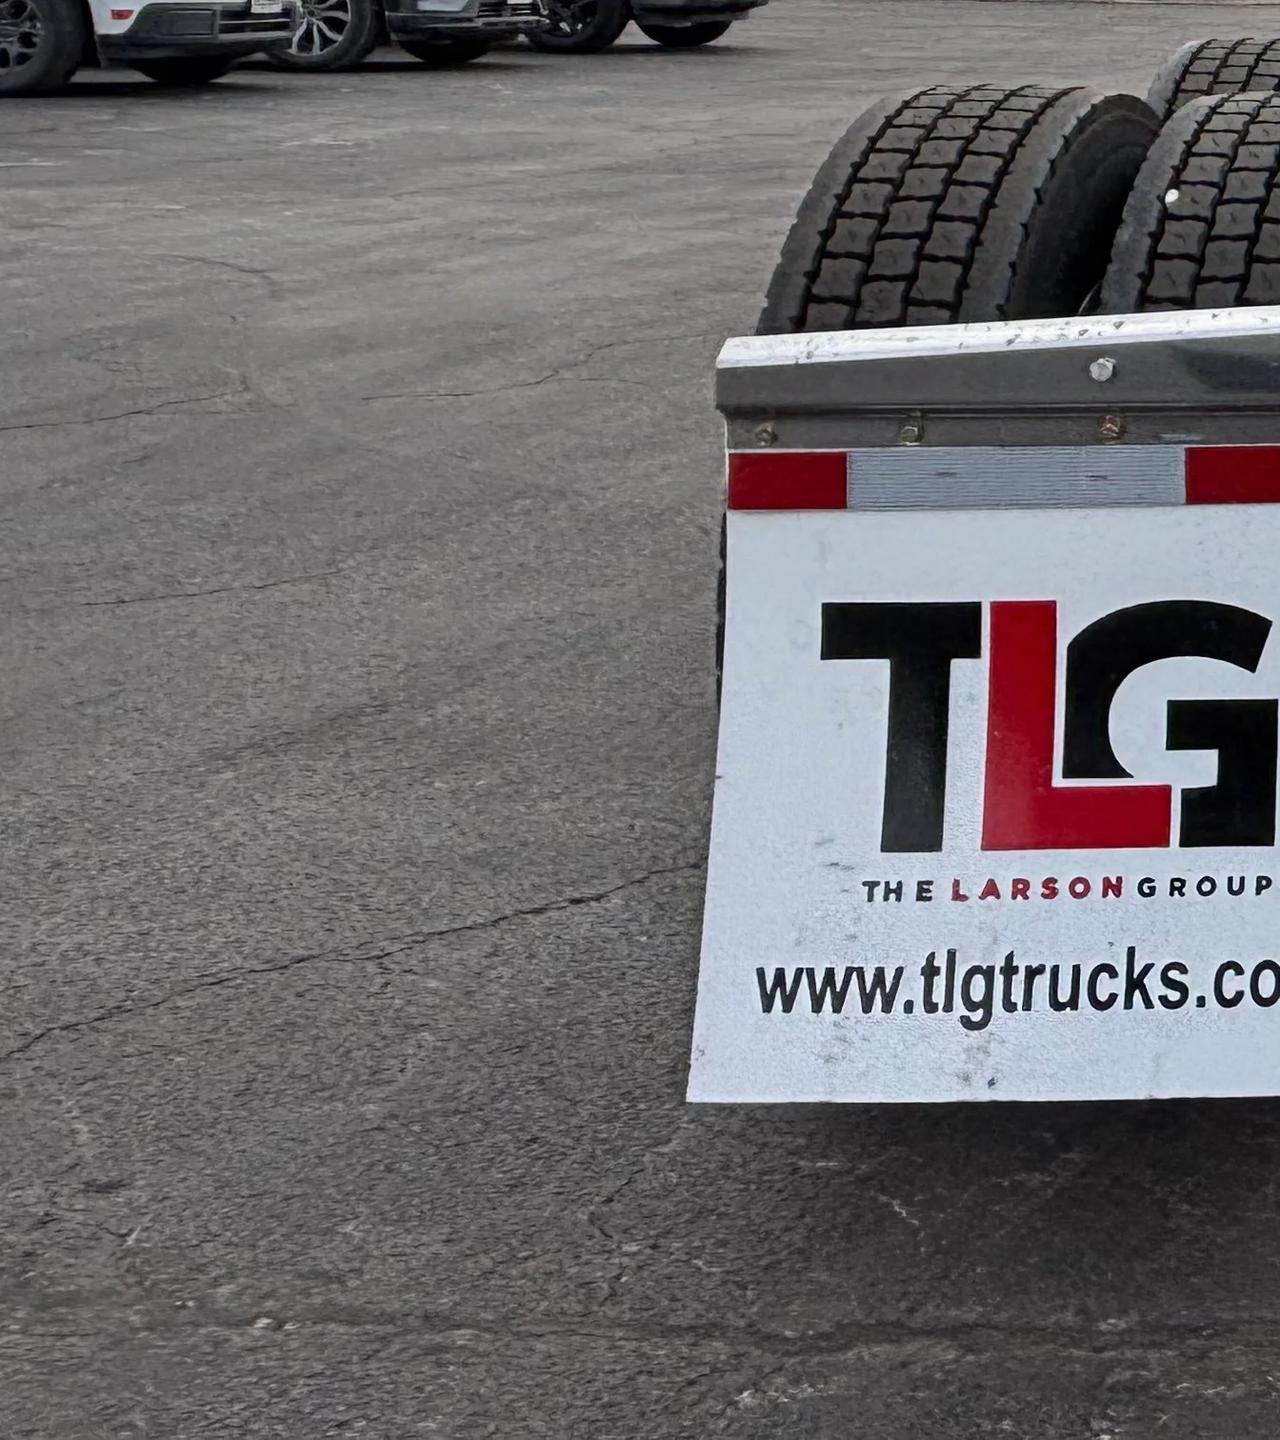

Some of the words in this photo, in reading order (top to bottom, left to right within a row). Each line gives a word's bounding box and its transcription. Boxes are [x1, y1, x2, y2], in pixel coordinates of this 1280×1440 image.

[819, 599, 1279, 853] TLG
[861, 879, 934, 903] THE
[951, 876, 1123, 903] LARSON
